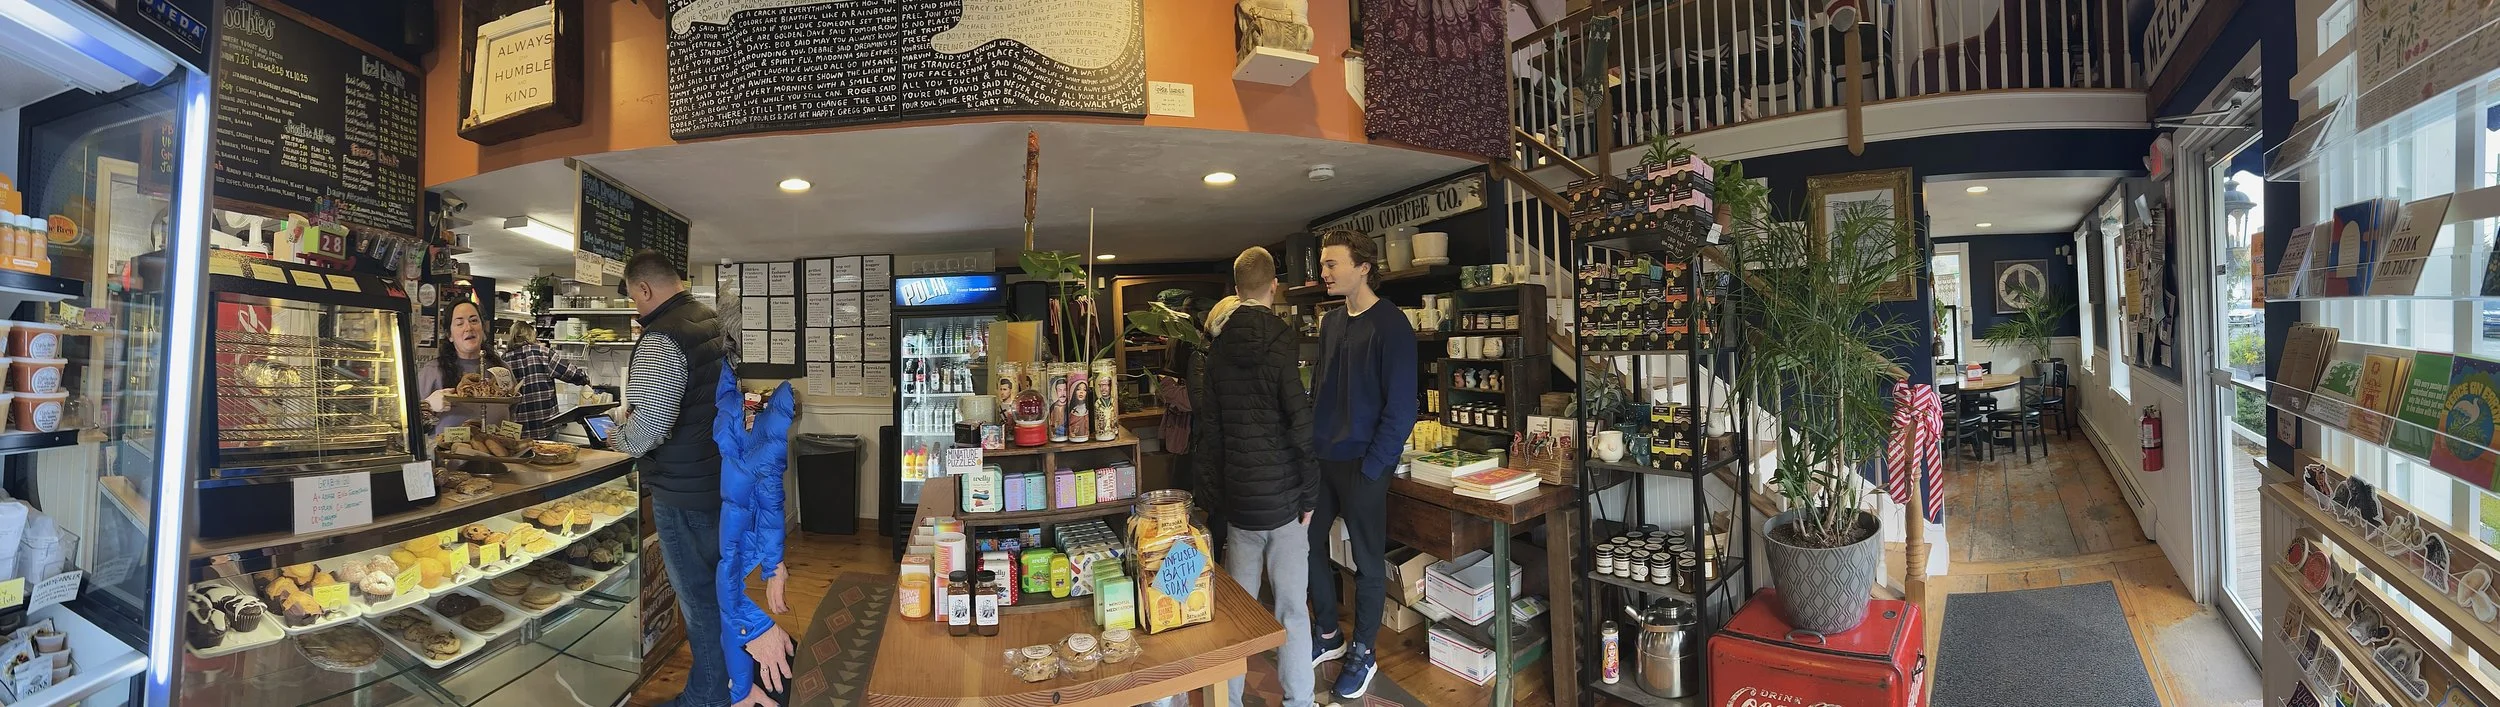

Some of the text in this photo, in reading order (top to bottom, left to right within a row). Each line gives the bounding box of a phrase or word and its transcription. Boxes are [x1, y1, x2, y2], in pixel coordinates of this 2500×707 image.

[789, 4, 832, 14] EVERYTHING
[921, 25, 950, 34] TRUTH
[2148, 0, 2195, 72] MEGA
[498, 33, 552, 58] ALWAYS
[902, 52, 931, 61] MARVIN
[934, 52, 954, 60] SAID
[974, 41, 996, 56] KNOW
[1022, 47, 1039, 57] GOT
[1042, 57, 1050, 65] TO
[1054, 60, 1070, 72] FIND
[495, 59, 552, 82] HUMBLE
[505, 87, 538, 103] KIND
[670, 96, 693, 107] JERRY
[696, 92, 712, 101] SAID
[716, 87, 734, 96] ONCE
[738, 83, 745, 91] IN
[749, 76, 777, 87] AWHILE
[817, 72, 844, 80] SHOWN
[952, 85, 979, 94] DAVID
[981, 80, 1001, 89] SAID
[1003, 80, 1031, 94] NEVER
[1034, 91, 1056, 104] LOOK
[671, 120, 696, 129] ROBERT
[699, 115, 714, 123] SAID
[751, 106, 773, 114] STILL
[816, 99, 848, 108] CHANGE
[875, 95, 897, 103] ROAD
[975, 98, 1000, 107] CARRY
[1379, 196, 1430, 229] COFFEE
[1437, 187, 1462, 211] CO.
[2388, 235, 2420, 253] DRINK
[2379, 259, 2417, 276] TO THAT
[901, 277, 949, 306] POLAR
[2445, 382, 2469, 411] PEACE
[2469, 381, 2484, 396] ON
[947, 449, 978, 459] MINIATURE
[948, 459, 976, 467] PUZZLES
[1164, 547, 1197, 567] INFUSED
[1163, 562, 1196, 583] BATH
[1165, 580, 1188, 597] SOAK
[1760, 689, 1803, 705] DRINK
